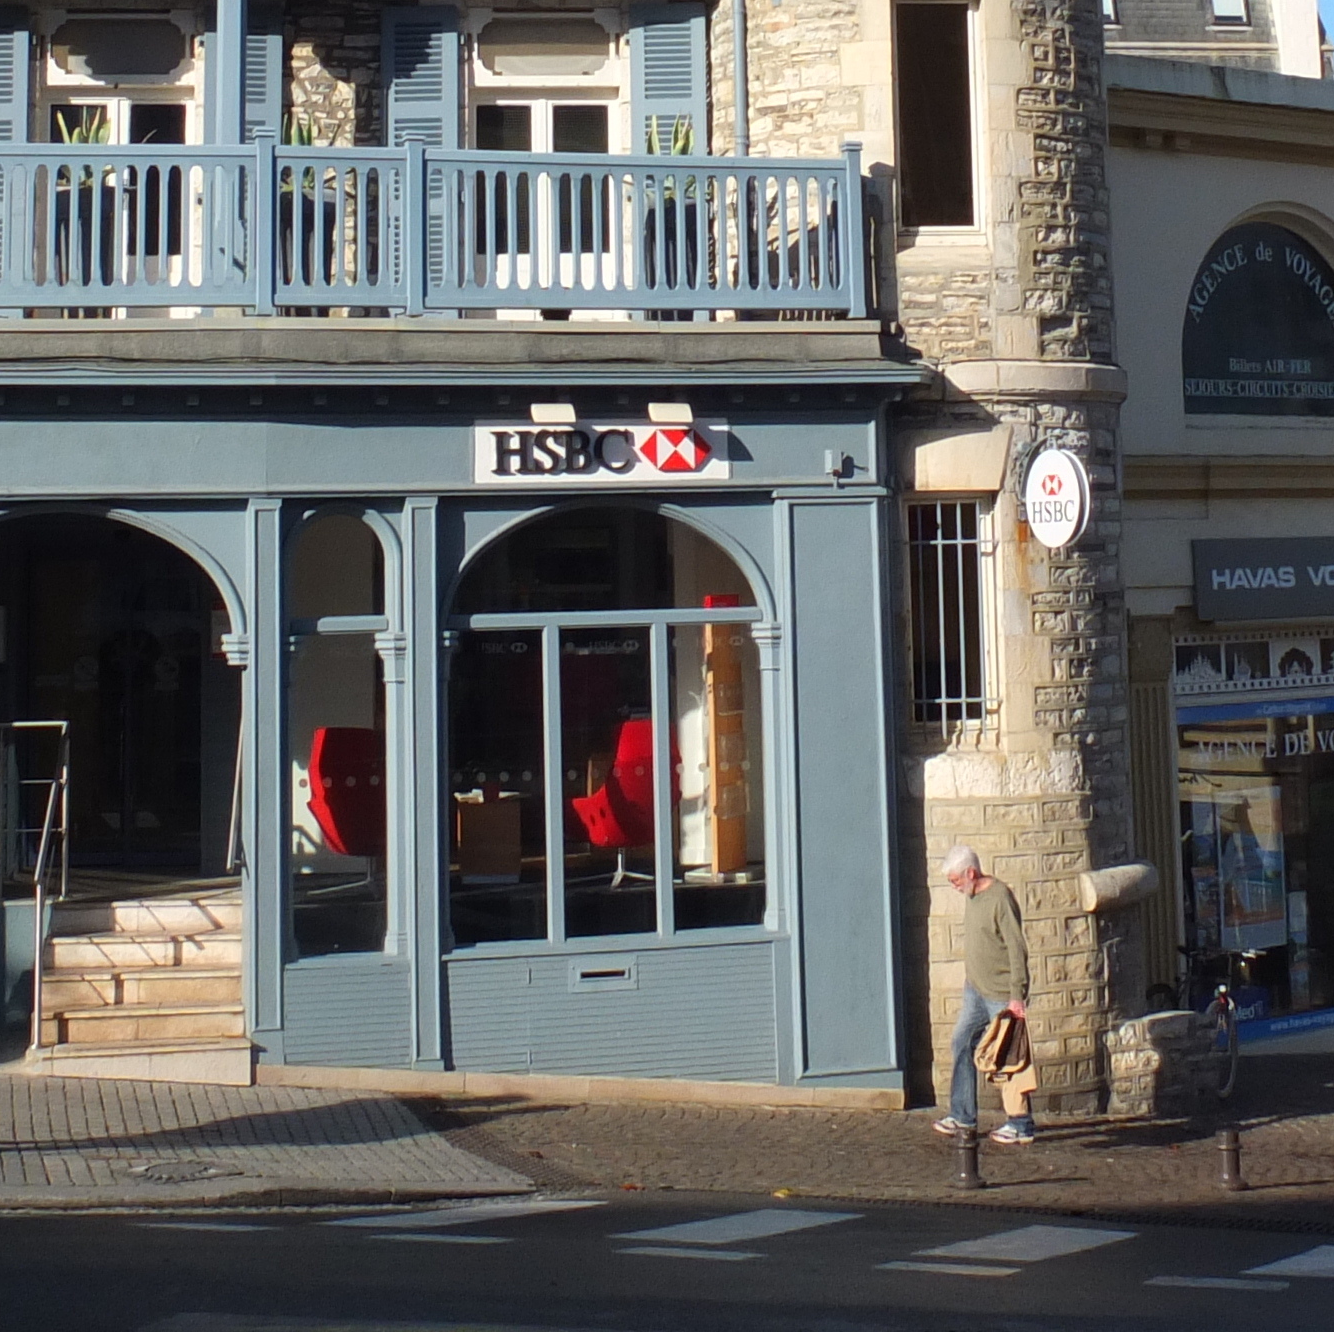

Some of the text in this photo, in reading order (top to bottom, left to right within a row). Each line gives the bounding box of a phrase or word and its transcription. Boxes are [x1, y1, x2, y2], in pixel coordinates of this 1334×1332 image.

[1188, 244, 1248, 323] AGENCE
[1255, 241, 1273, 261] de
[490, 429, 636, 475] HSBC
[1032, 500, 1075, 524] HSBC
[1212, 566, 1296, 590] HAVAS
[1197, 733, 1278, 758] AGENCE
